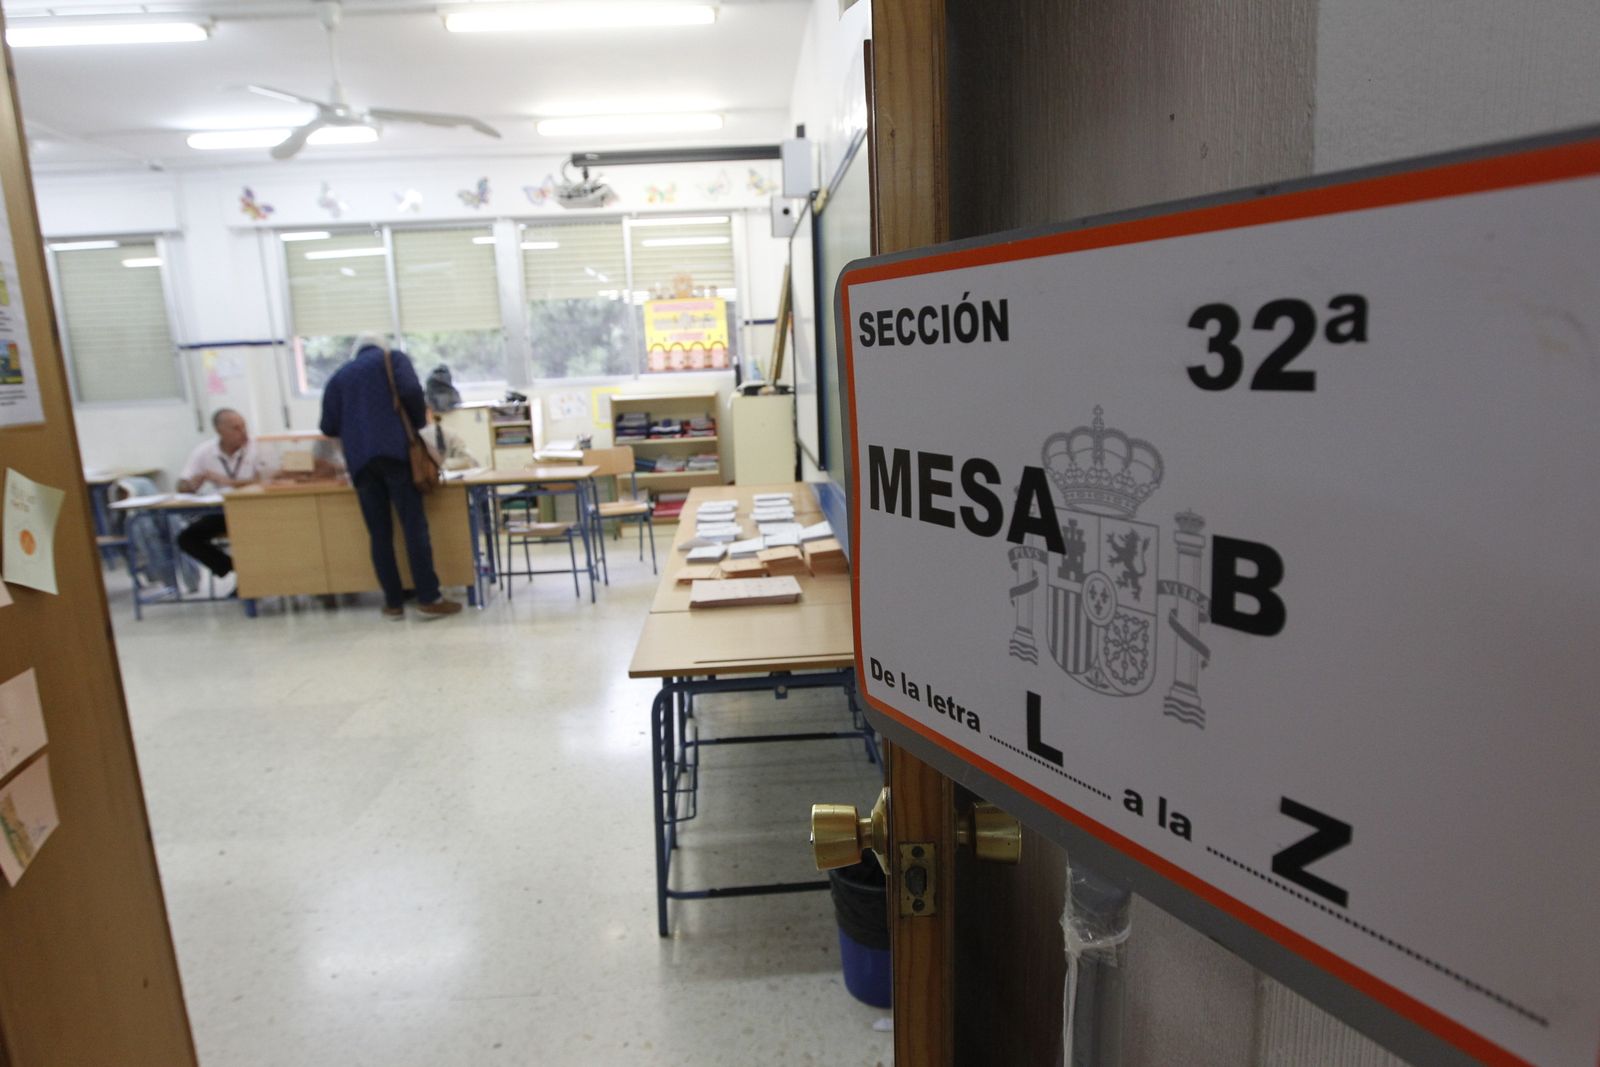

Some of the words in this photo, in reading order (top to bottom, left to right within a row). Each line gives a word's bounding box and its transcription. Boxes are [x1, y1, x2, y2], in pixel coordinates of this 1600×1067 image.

[859, 291, 1010, 347] SECCIÓN
[867, 444, 1068, 557] MESA
[1211, 534, 1287, 638] B
[869, 656, 896, 689] De
[900, 671, 921, 702] la
[926, 684, 981, 733] letra
[1026, 690, 1064, 768] L
[1123, 788, 1145, 817] a
[1158, 796, 1192, 842] la
[1270, 795, 1354, 909] Z
